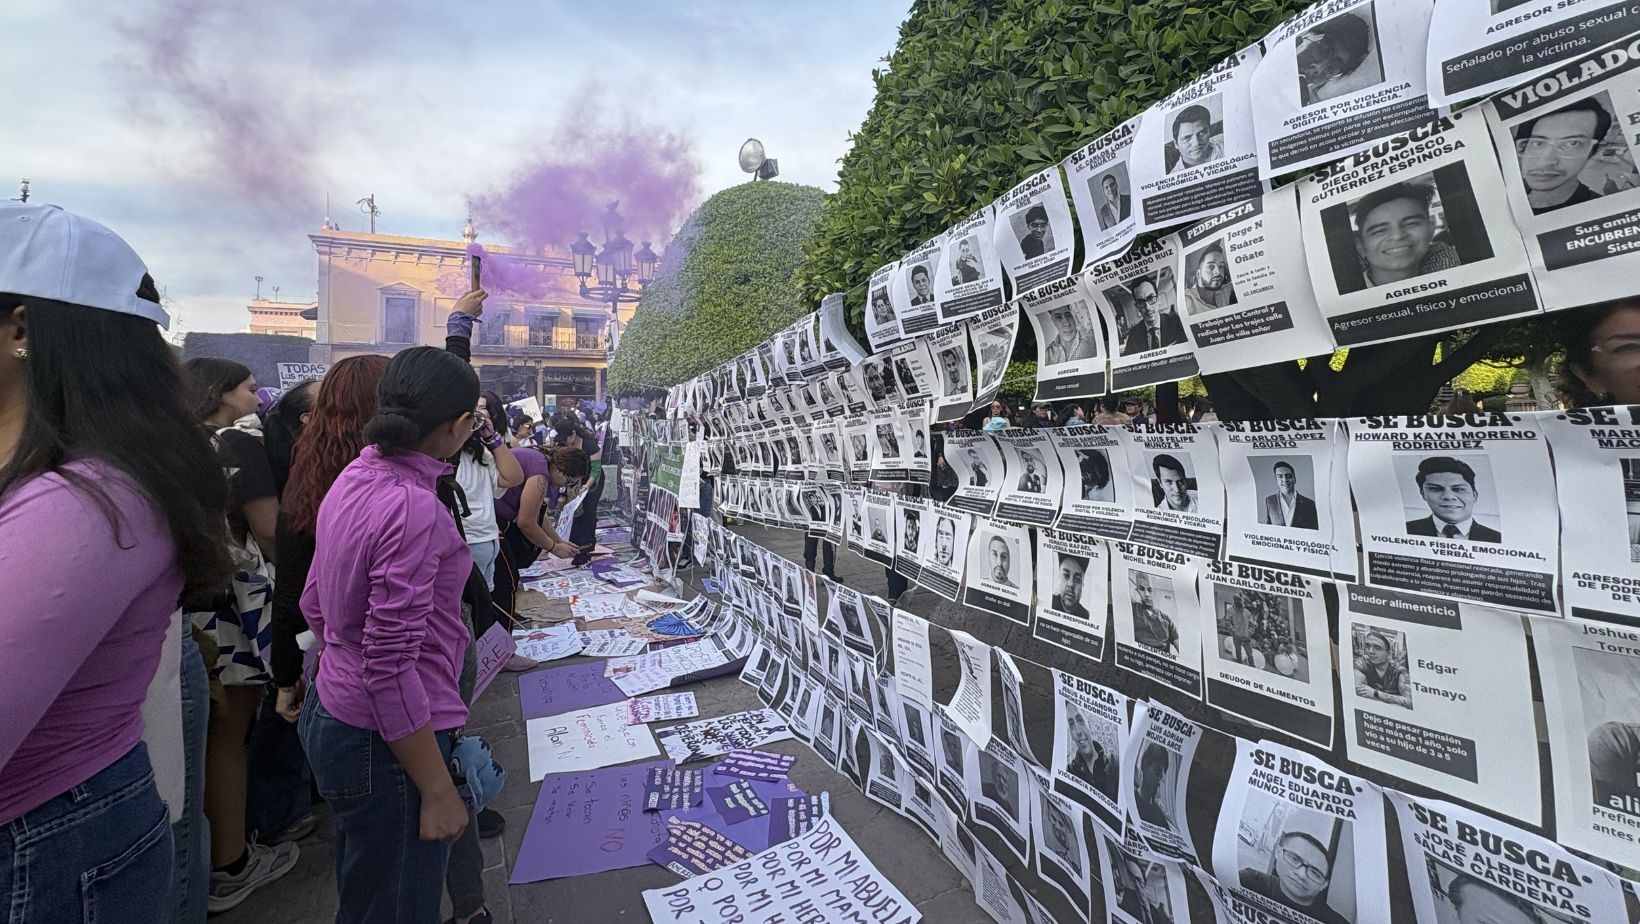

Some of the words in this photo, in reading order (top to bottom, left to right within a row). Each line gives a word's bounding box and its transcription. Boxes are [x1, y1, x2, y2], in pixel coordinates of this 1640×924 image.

[1486, 6, 1552, 34] AGRESOR
[1447, 50, 1502, 73] Señalado
[1506, 41, 1529, 56] por
[1533, 26, 1574, 45] abuso
[1579, 7, 1626, 30] sexual
[1521, 55, 1533, 64] la
[1537, 38, 1591, 58] víctima.
[1283, 107, 1327, 126] AGRESOR
[1330, 101, 1351, 112] POR
[1354, 82, 1411, 105] VIOLENCIA
[1292, 113, 1329, 130] DIGITAL
[1342, 94, 1402, 113] VIOLENCIA.
[1072, 150, 1086, 165] SE
[1088, 124, 1133, 156] BUSCA
[1316, 162, 1345, 184] SE
[1353, 115, 1455, 168] BUSCA
[1141, 176, 1175, 190] VIOLENCIA
[1203, 152, 1257, 171] PSICOLÓGICA,
[1312, 171, 1385, 203] GUTIERREZ
[1389, 140, 1465, 174] ESPINOSA
[1322, 171, 1359, 191] DIEGO
[1363, 136, 1445, 175] FRANCISCO
[1187, 202, 1255, 240] PEDERASTA
[1227, 225, 1252, 241] Jorge
[1255, 220, 1263, 229] N
[1575, 225, 1600, 235] Sus
[1230, 235, 1264, 252] Suárez
[1092, 271, 1119, 285] VICTOR
[1120, 257, 1154, 277] EDUARDO
[1155, 249, 1174, 261] RUIZ
[1093, 262, 1112, 277] SE
[1115, 240, 1163, 269] BUSCA
[1235, 250, 1264, 264] Oñate
[1119, 267, 1150, 282] RAMIREZ
[1023, 290, 1037, 302] SE
[1039, 276, 1076, 297] BUSCA
[1028, 295, 1052, 308] SALVADOR
[1052, 288, 1077, 301] RANGEL
[1385, 279, 1448, 299] AGRESOR
[1334, 316, 1373, 330] Agresor
[1375, 307, 1414, 322] sexual,
[1415, 299, 1447, 314] físico
[1449, 299, 1457, 308] y
[1459, 282, 1527, 304] emocional
[1210, 335, 1225, 343] Juan
[1235, 329, 1250, 337] villa
[1251, 325, 1271, 334] señor
[1139, 349, 1167, 360] AGRESOR
[283, 364, 325, 373] TODAS
[1053, 427, 1065, 437] SE
[1067, 425, 1108, 436] BUSCA
[1124, 424, 1139, 433] SE
[1144, 423, 1198, 434] BUSCA
[1226, 420, 1246, 432] SE
[1250, 419, 1322, 433] BUSCA
[1367, 416, 1398, 430] SE
[1405, 412, 1513, 429] BUSCA
[1245, 434, 1285, 442] CARLOS
[1289, 432, 1325, 440] LÓPEZ
[1355, 432, 1409, 441] HOWARD
[1413, 432, 1458, 440] KAYN
[1461, 430, 1537, 439] MORENO
[1393, 440, 1484, 450] RODRIGUEZ
[1135, 508, 1162, 516] VIOLENCIA
[1182, 515, 1222, 526] PSICOLÓGICA,
[1146, 515, 1178, 524] ECONÓMICA
[1118, 542, 1134, 555] SE
[1137, 545, 1186, 565] BUSCA
[1244, 533, 1281, 543] VIOLENCIA
[1283, 538, 1338, 552] PSICOLÓGICA,
[1251, 540, 1294, 551] EMOCIONAL
[1303, 546, 1329, 556] FÍSICA
[1371, 535, 1426, 547] VIOLENCIA
[1429, 541, 1469, 552] FÍSICA,
[1472, 545, 1547, 561] EMOCIONAL,
[1432, 548, 1476, 559] VERBAL
[1123, 554, 1146, 565] MICHEL
[1148, 560, 1177, 571] ROMERO
[1211, 560, 1233, 576] SE
[1237, 564, 1306, 589] BUSCA
[1205, 573, 1228, 584] JUAN
[1230, 578, 1266, 591] CARLOS
[1269, 585, 1313, 599] ARANDA
[1578, 580, 1596, 589] DE
[1351, 593, 1387, 606] Deudor
[1389, 600, 1456, 617] alimenticio
[1612, 593, 1631, 602] DE
[1583, 624, 1638, 640] Joshue
[1417, 658, 1459, 675] Edgar
[1061, 673, 1074, 688] SE
[1076, 679, 1117, 706] BUSCA
[1062, 686, 1079, 697] JESÚS
[1079, 694, 1118, 716] ALEJANDRO
[1219, 672, 1251, 687] DEUDOR
[1253, 682, 1264, 690] DE
[1266, 685, 1316, 707] ALIMENTOS
[1412, 681, 1467, 701] Tamayo
[751, 714, 768, 724] EN
[1148, 707, 1160, 723] SE
[1161, 713, 1193, 737] BUSCA
[1362, 712, 1382, 724] Dejo
[1383, 718, 1394, 726] de
[1395, 721, 1421, 734] pasar
[1423, 729, 1462, 746] pensión
[544, 726, 569, 747] Alan
[1146, 730, 1166, 745] MOJICA
[1166, 738, 1182, 751] ARCE
[1150, 724, 1163, 733] LUIS
[1163, 730, 1184, 743] ADRIAN
[1365, 739, 1391, 752] veces
[1253, 749, 1275, 770] SE
[1279, 757, 1355, 796] BUSCA
[1248, 776, 1285, 798] MUÑOZ
[1288, 793, 1357, 820] GUEVARA
[1252, 768, 1285, 788] ANGEL
[1288, 782, 1354, 808] EDUARDO
[600, 828, 625, 852] NO
[1592, 823, 1633, 841] antes
[803, 820, 841, 861] POR
[826, 850, 860, 880] MI
[1415, 802, 1448, 835] SE
[1455, 820, 1583, 887] BUSCA
[760, 851, 786, 881] POR
[775, 880, 803, 899] MI
[781, 842, 811, 871] POR
[800, 868, 828, 887] MI
[1413, 832, 1465, 867] SALAS
[1470, 863, 1592, 918] CARDENAS
[1423, 829, 1467, 857] JOSÉ
[1473, 852, 1574, 899] ALBERTO
[727, 862, 758, 890] POR
[746, 889, 773, 912] MI
[662, 888, 695, 920] POR
